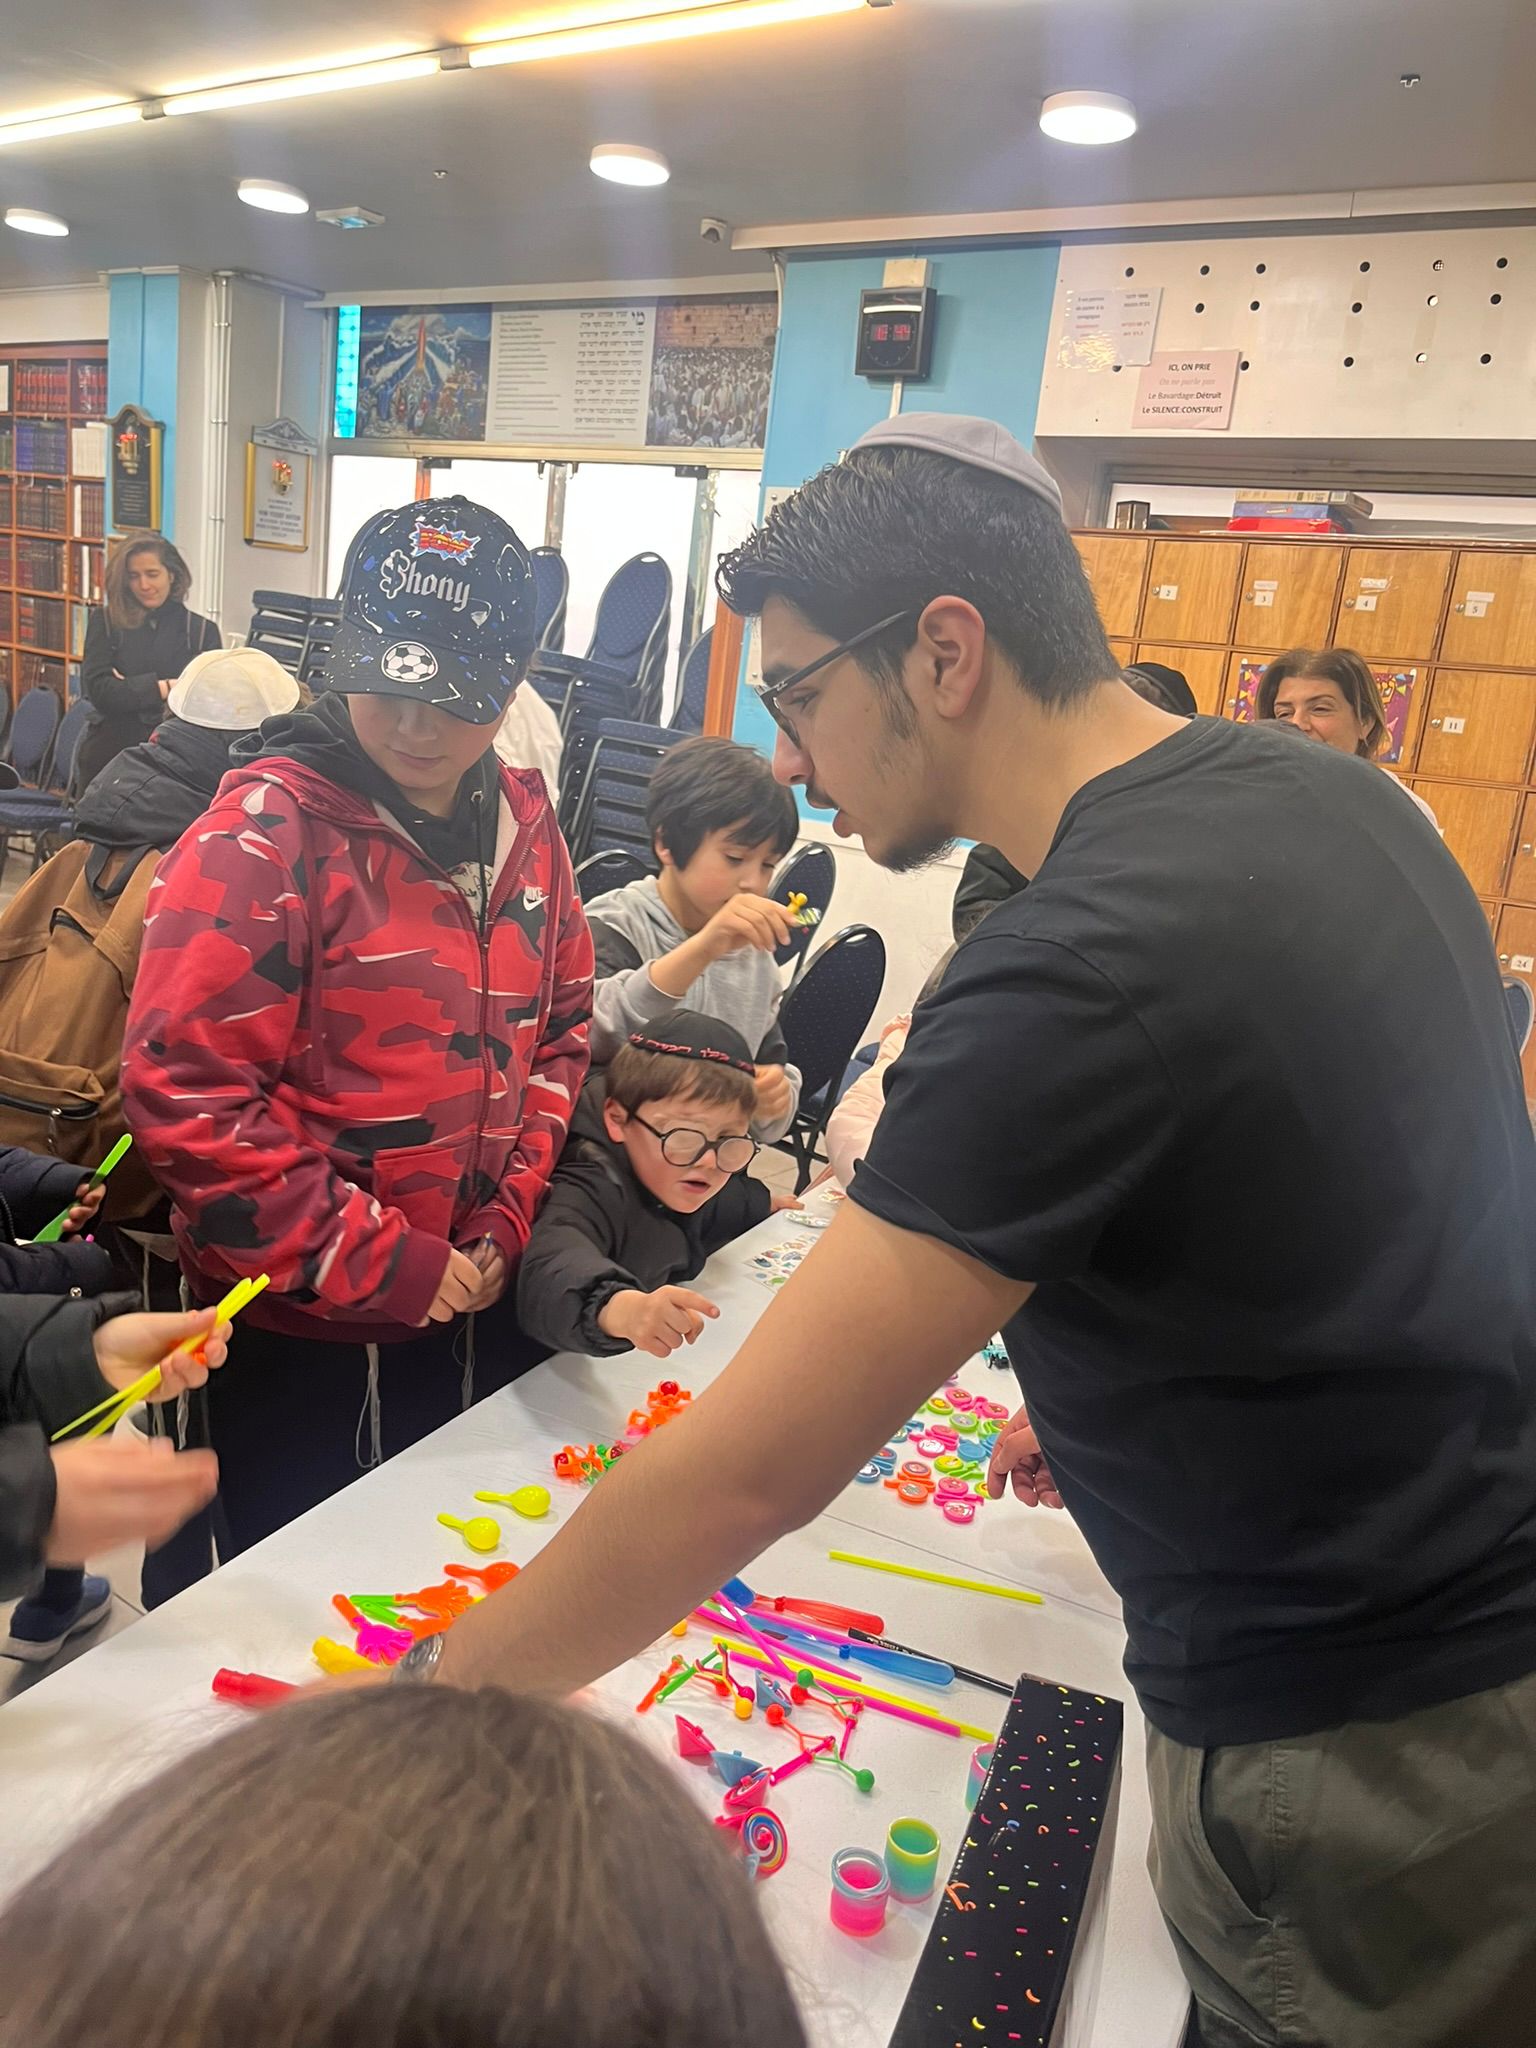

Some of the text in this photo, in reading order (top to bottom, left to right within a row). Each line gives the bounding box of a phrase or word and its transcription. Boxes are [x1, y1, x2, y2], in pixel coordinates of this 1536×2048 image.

[1181, 363, 1193, 371] ON
[1194, 363, 1212, 371] PRIE
[1148, 392, 1157, 400] Le
[1181, 405, 1223, 414] CONSTRUIT
[1448, 721, 1459, 731] 11
